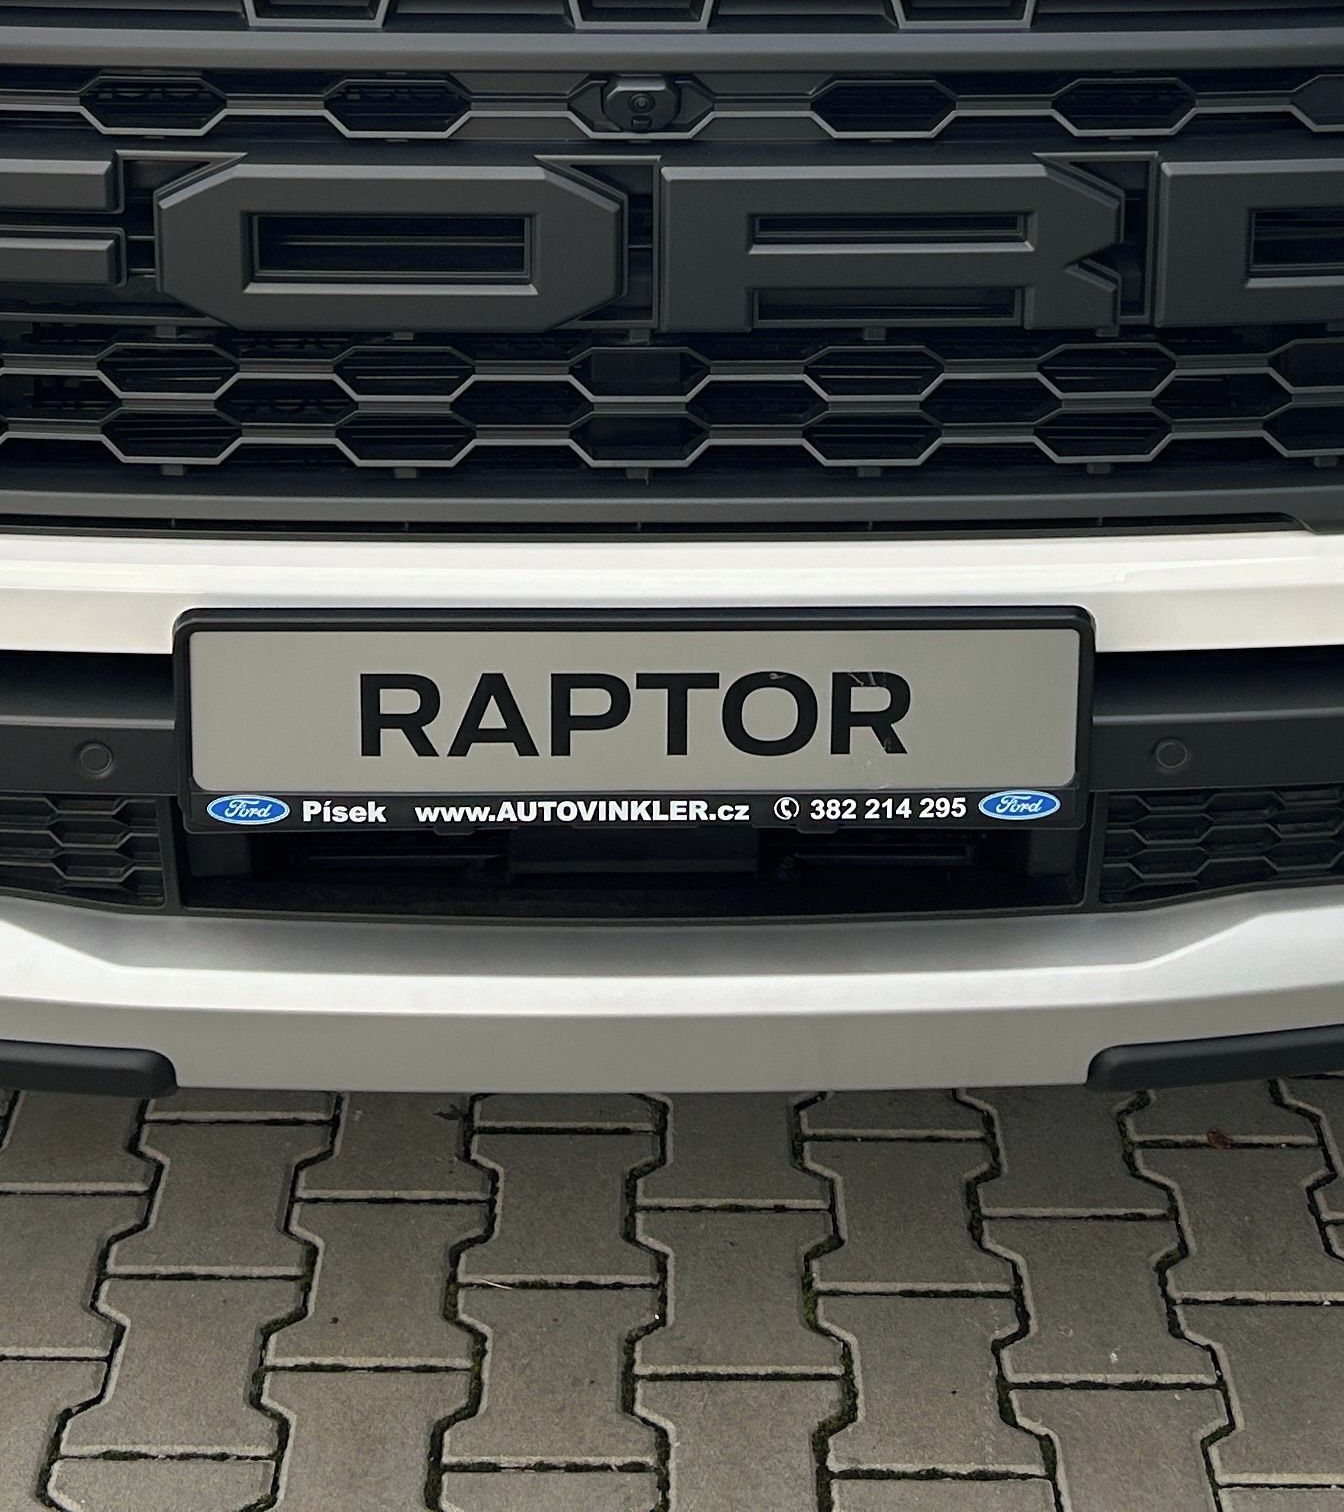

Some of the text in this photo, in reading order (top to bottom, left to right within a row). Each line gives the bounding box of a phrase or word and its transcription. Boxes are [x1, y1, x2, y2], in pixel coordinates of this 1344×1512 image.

[360, 671, 910, 757] RAPTOR
[302, 796, 967, 823] Písek www.AUTOVINKLER.cz 382 214 295
